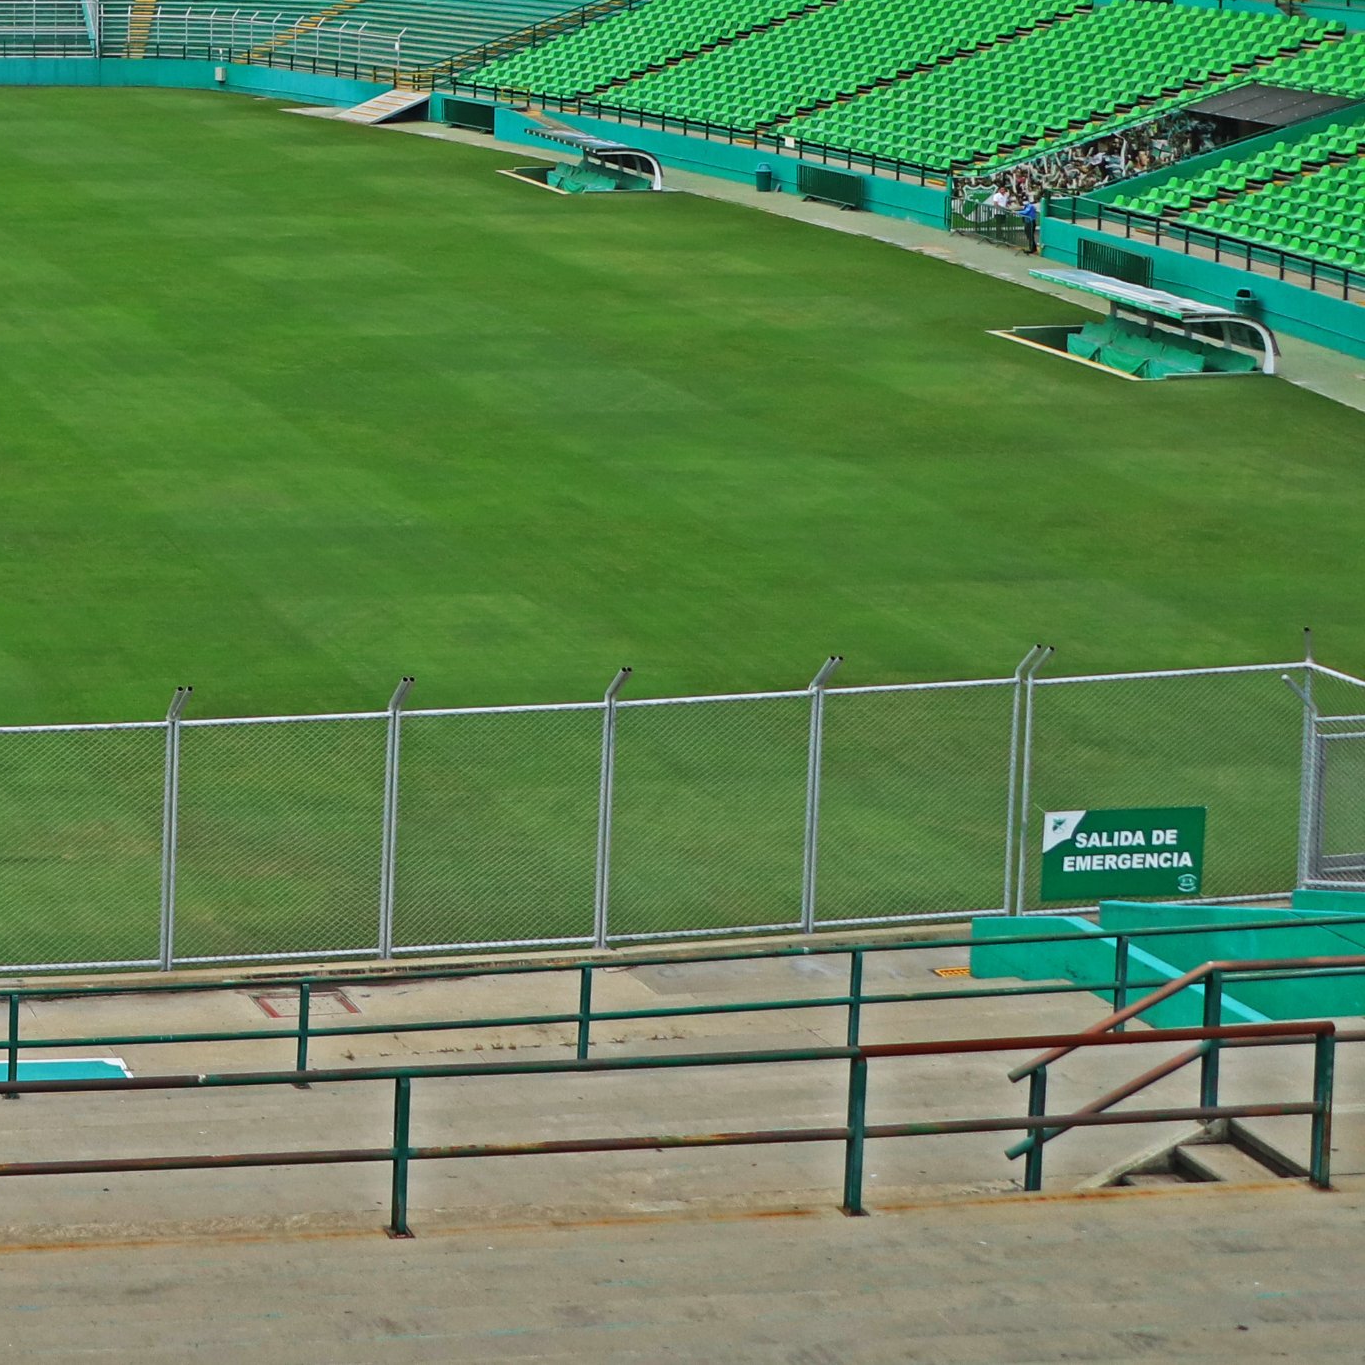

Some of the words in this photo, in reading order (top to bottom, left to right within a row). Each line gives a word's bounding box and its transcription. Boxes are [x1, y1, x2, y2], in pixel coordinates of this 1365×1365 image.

[1074, 829, 1146, 849] SALIDA
[1151, 828, 1178, 846] DE
[1062, 851, 1193, 873] EMERGENCIA
